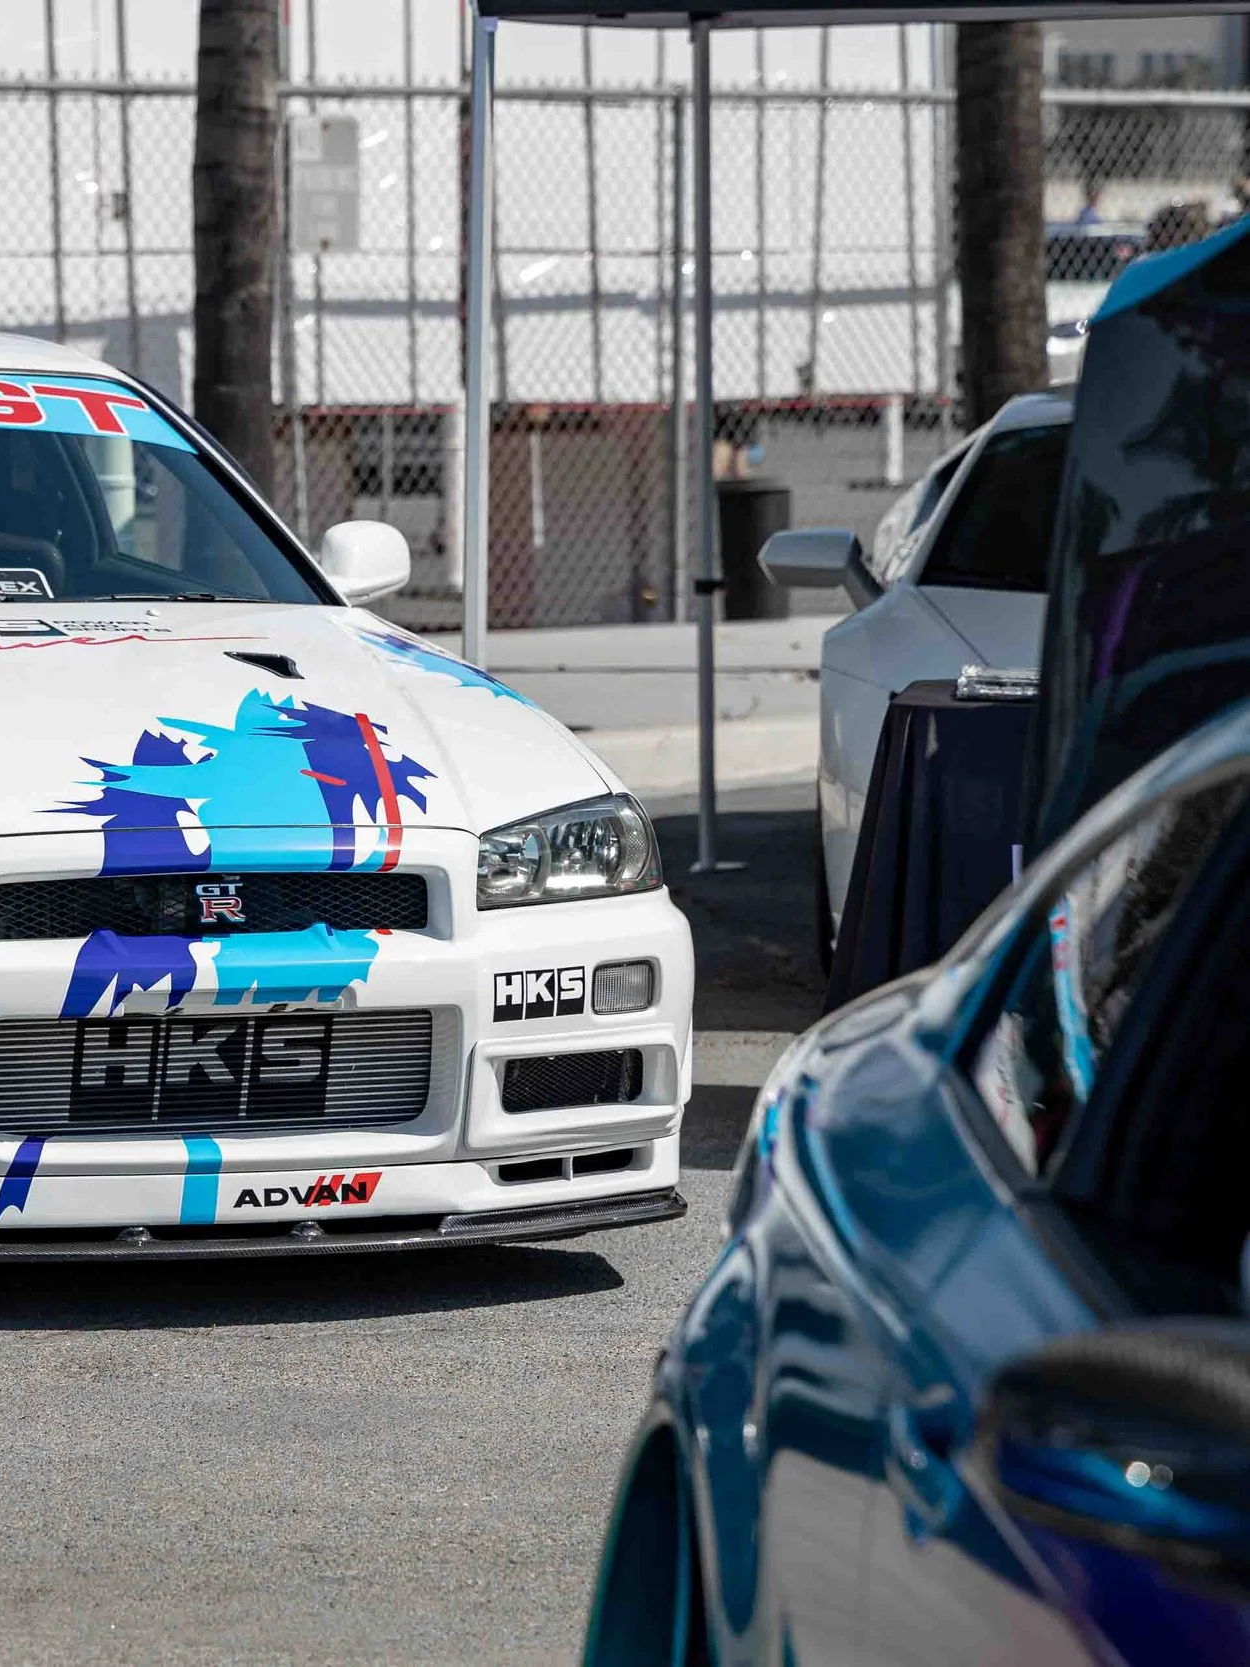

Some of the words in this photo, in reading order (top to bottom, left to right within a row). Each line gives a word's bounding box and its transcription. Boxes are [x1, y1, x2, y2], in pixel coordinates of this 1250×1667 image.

[195, 883, 243, 896] GT
[199, 896, 246, 922] R
[494, 967, 585, 1014] HKS
[74, 1017, 329, 1100] HKS
[232, 1180, 369, 1209] ADVAN
